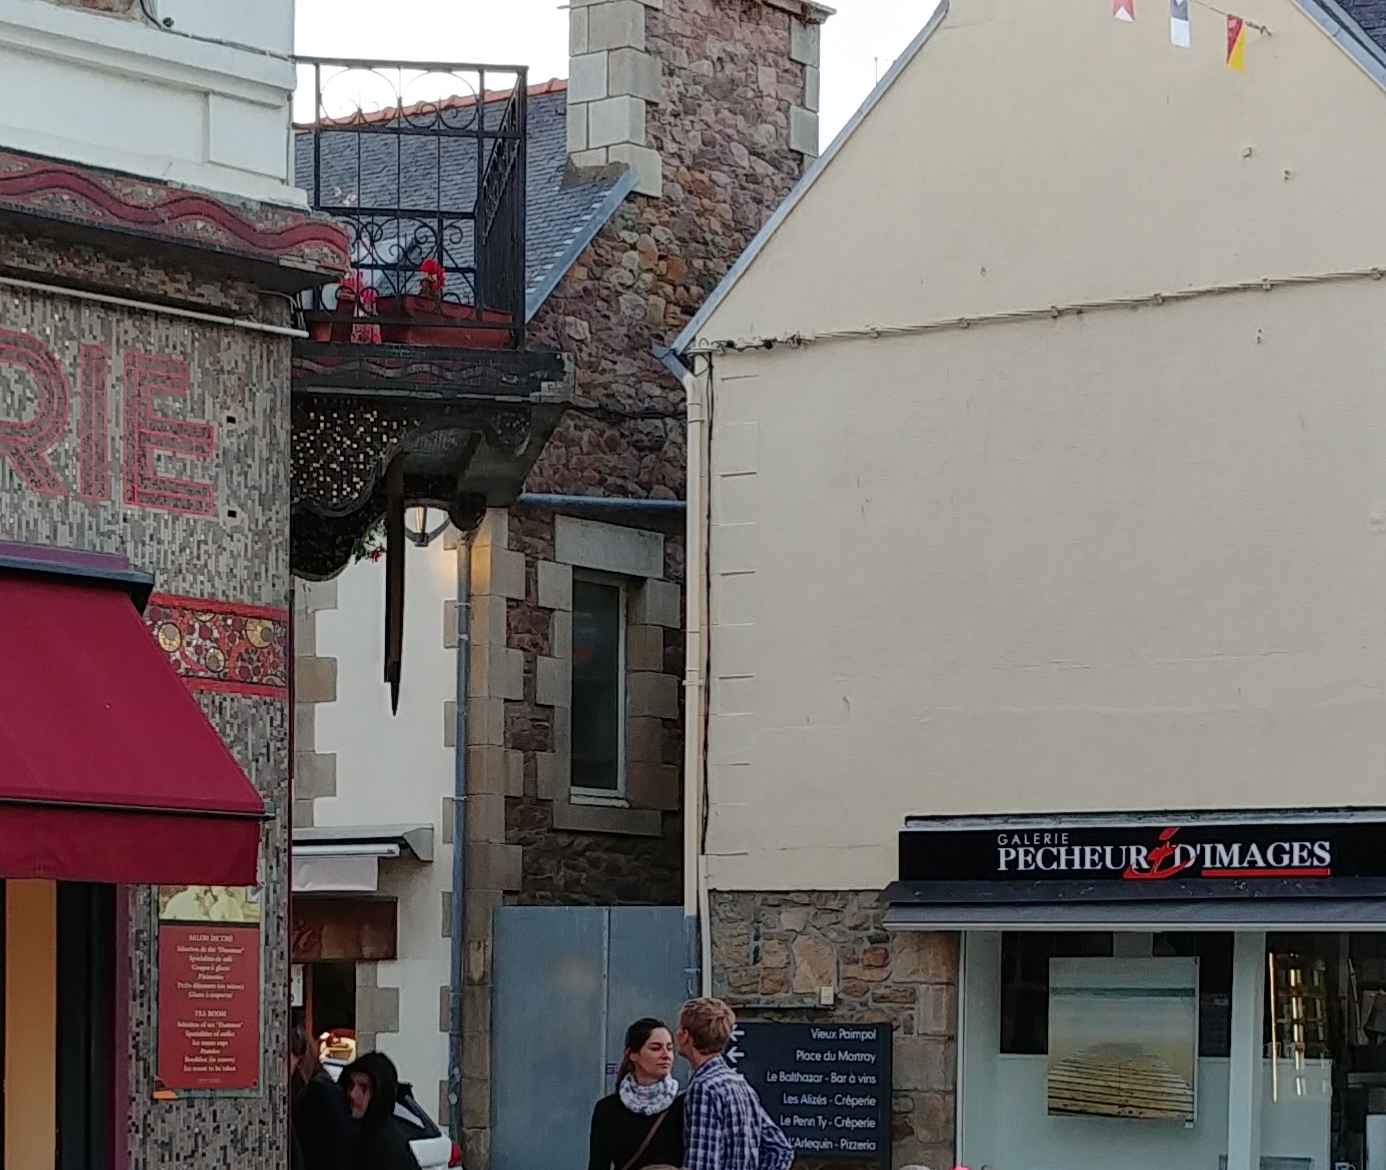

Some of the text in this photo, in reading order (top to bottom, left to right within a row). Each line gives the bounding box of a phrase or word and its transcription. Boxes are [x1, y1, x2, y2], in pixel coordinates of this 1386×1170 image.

[997, 832, 1070, 846] GALERIE
[194, 1009, 227, 1017] TEA ROOM
[811, 1028, 877, 1041] Vieux Paimpol
[796, 1049, 877, 1064] Place du Martray
[767, 1070, 778, 1082] Le
[779, 1071, 824, 1083] Balthazar
[830, 1071, 847, 1084] Bar
[848, 1070, 856, 1084] à
[857, 1072, 877, 1085] vins
[783, 1093, 799, 1105] Les
[800, 1093, 828, 1106] Alizés
[834, 1094, 877, 1109] Crêperie
[780, 1114, 791, 1126] Le
[793, 1115, 816, 1127] Penn
[816, 1115, 828, 1130] Ty
[834, 1116, 877, 1131] Crêperie
[840, 1138, 877, 1151] Pizzeria
